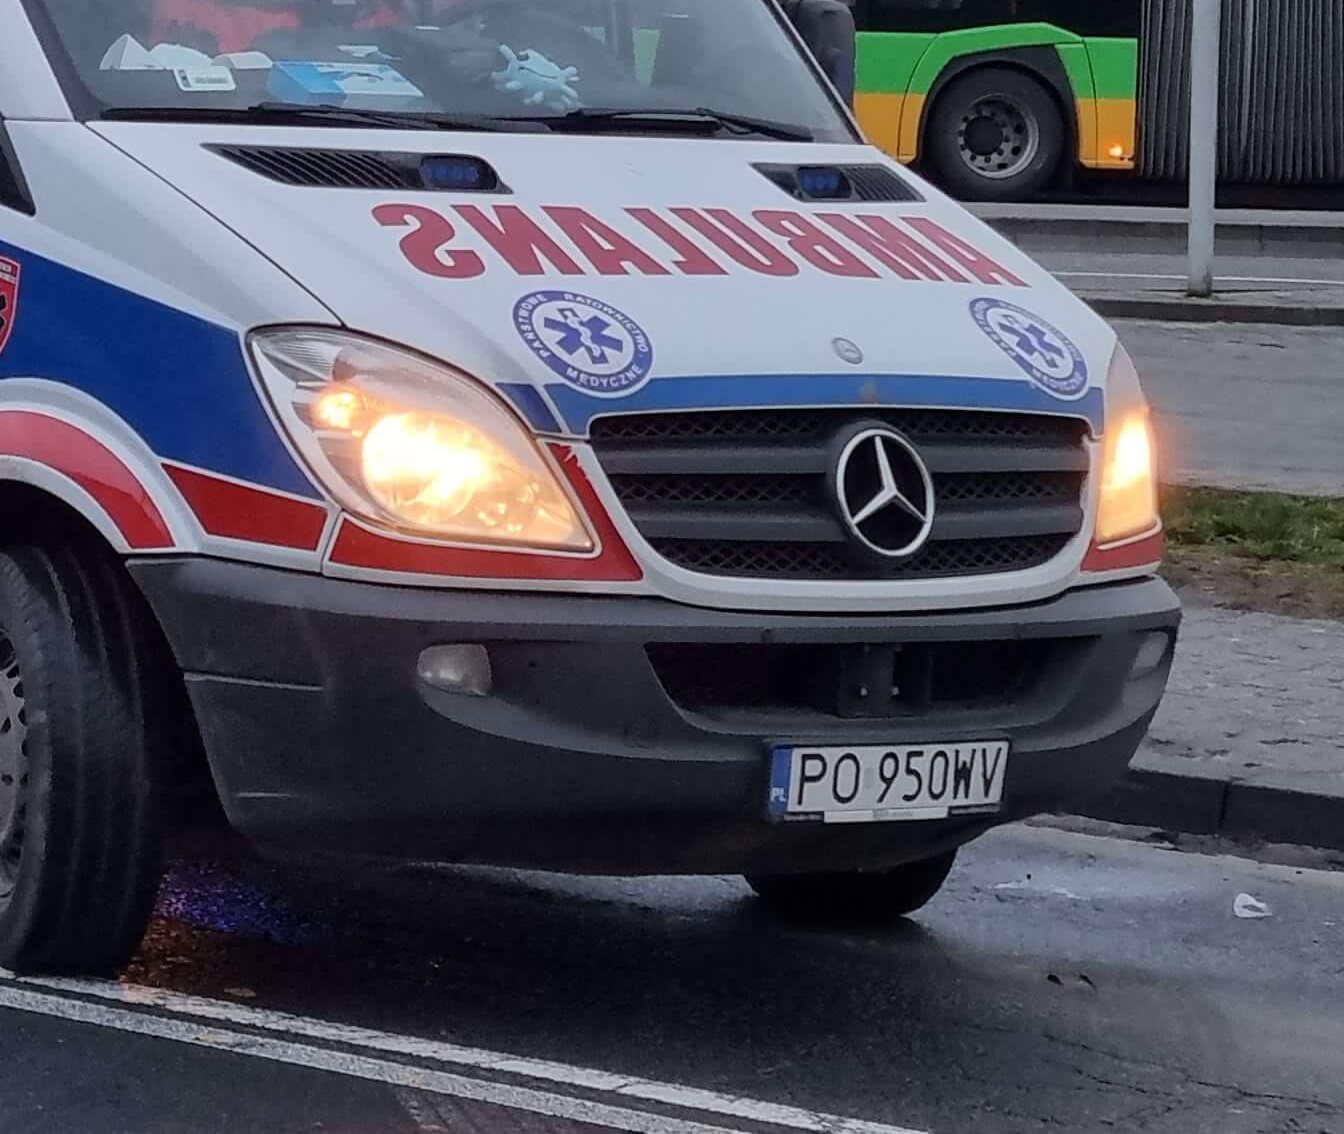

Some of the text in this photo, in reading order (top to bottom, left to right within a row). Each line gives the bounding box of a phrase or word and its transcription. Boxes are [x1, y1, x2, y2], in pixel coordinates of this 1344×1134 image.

[565, 363, 643, 387] MEDYCZNE
[797, 747, 1003, 806] PO 950WV
